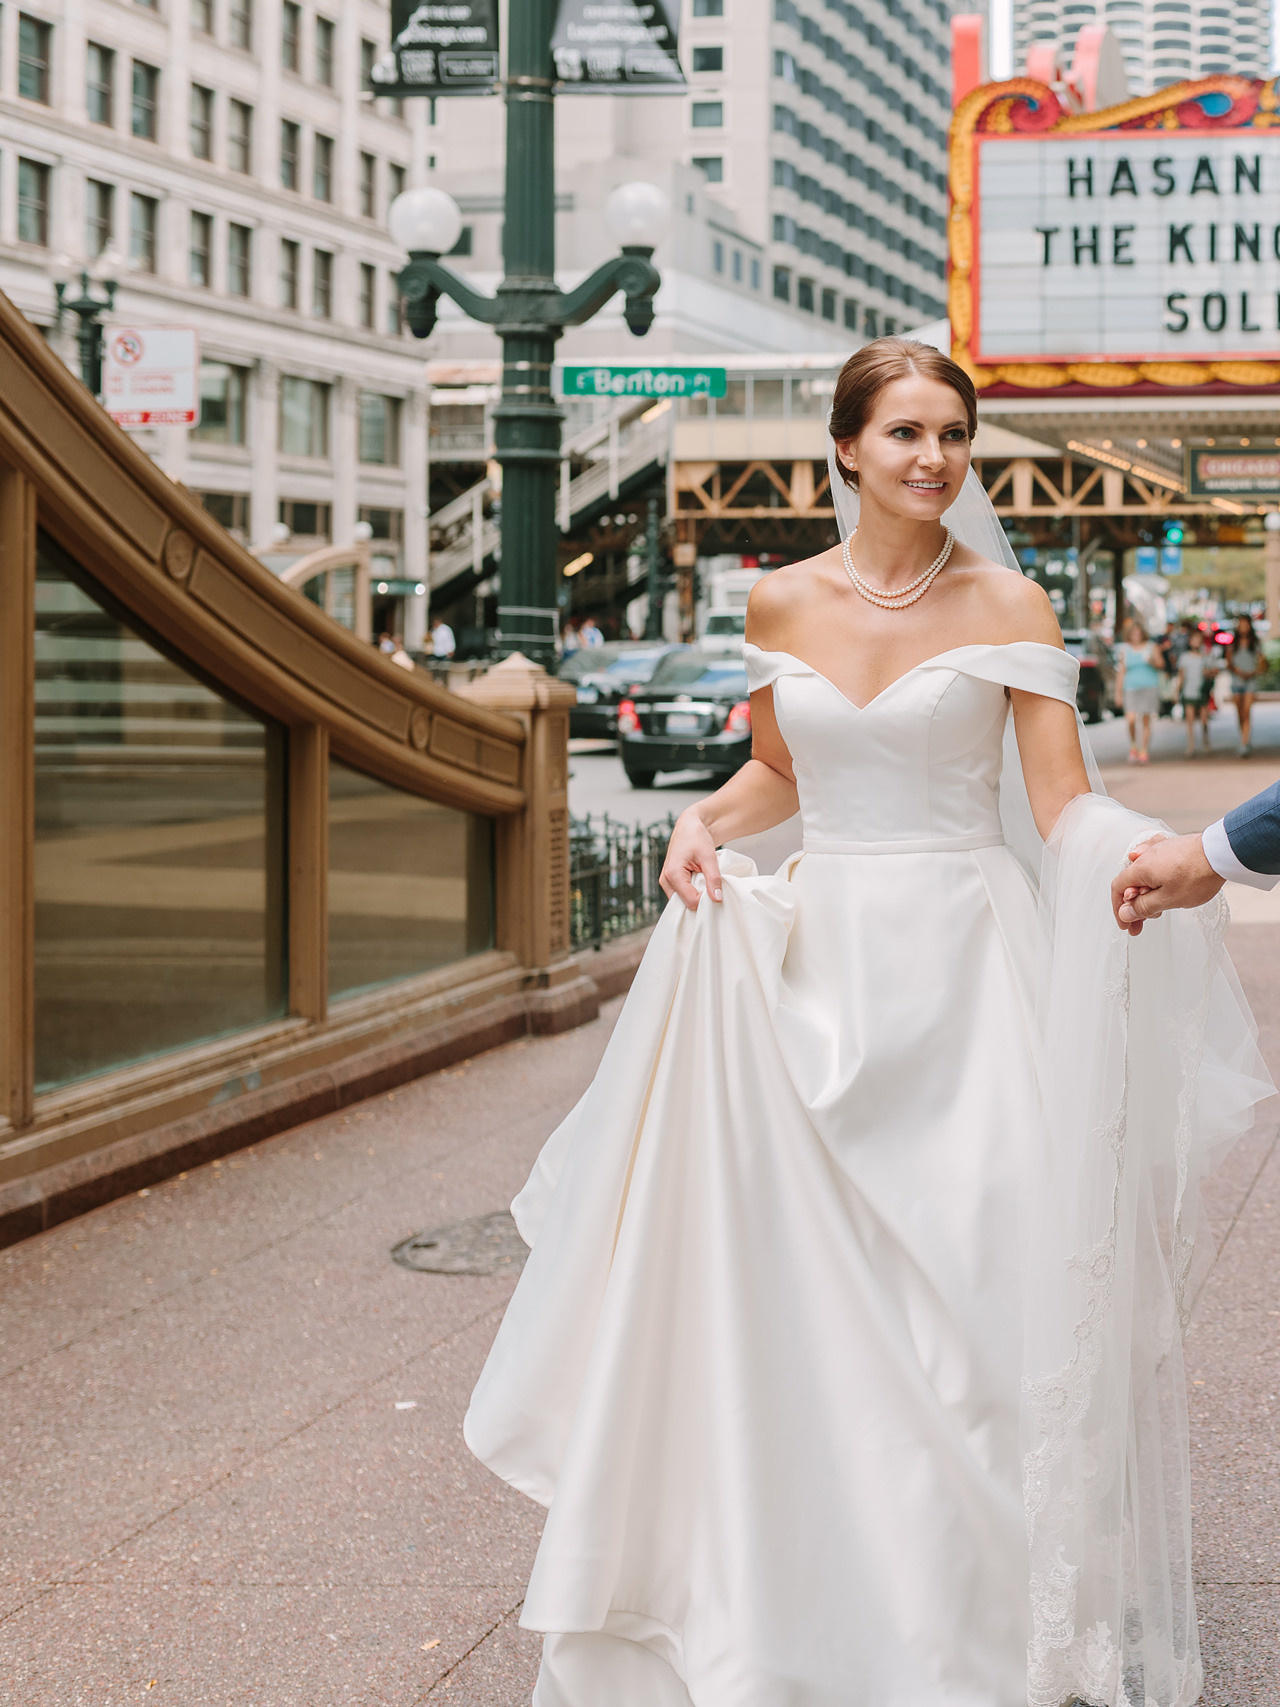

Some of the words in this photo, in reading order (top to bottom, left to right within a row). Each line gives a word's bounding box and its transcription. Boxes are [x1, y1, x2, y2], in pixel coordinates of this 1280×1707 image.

[1067, 155, 1261, 198] HASAN
[1034, 224, 1135, 266] THE
[594, 369, 685, 394] Benton
[1206, 459, 1280, 475] CHICAGO
